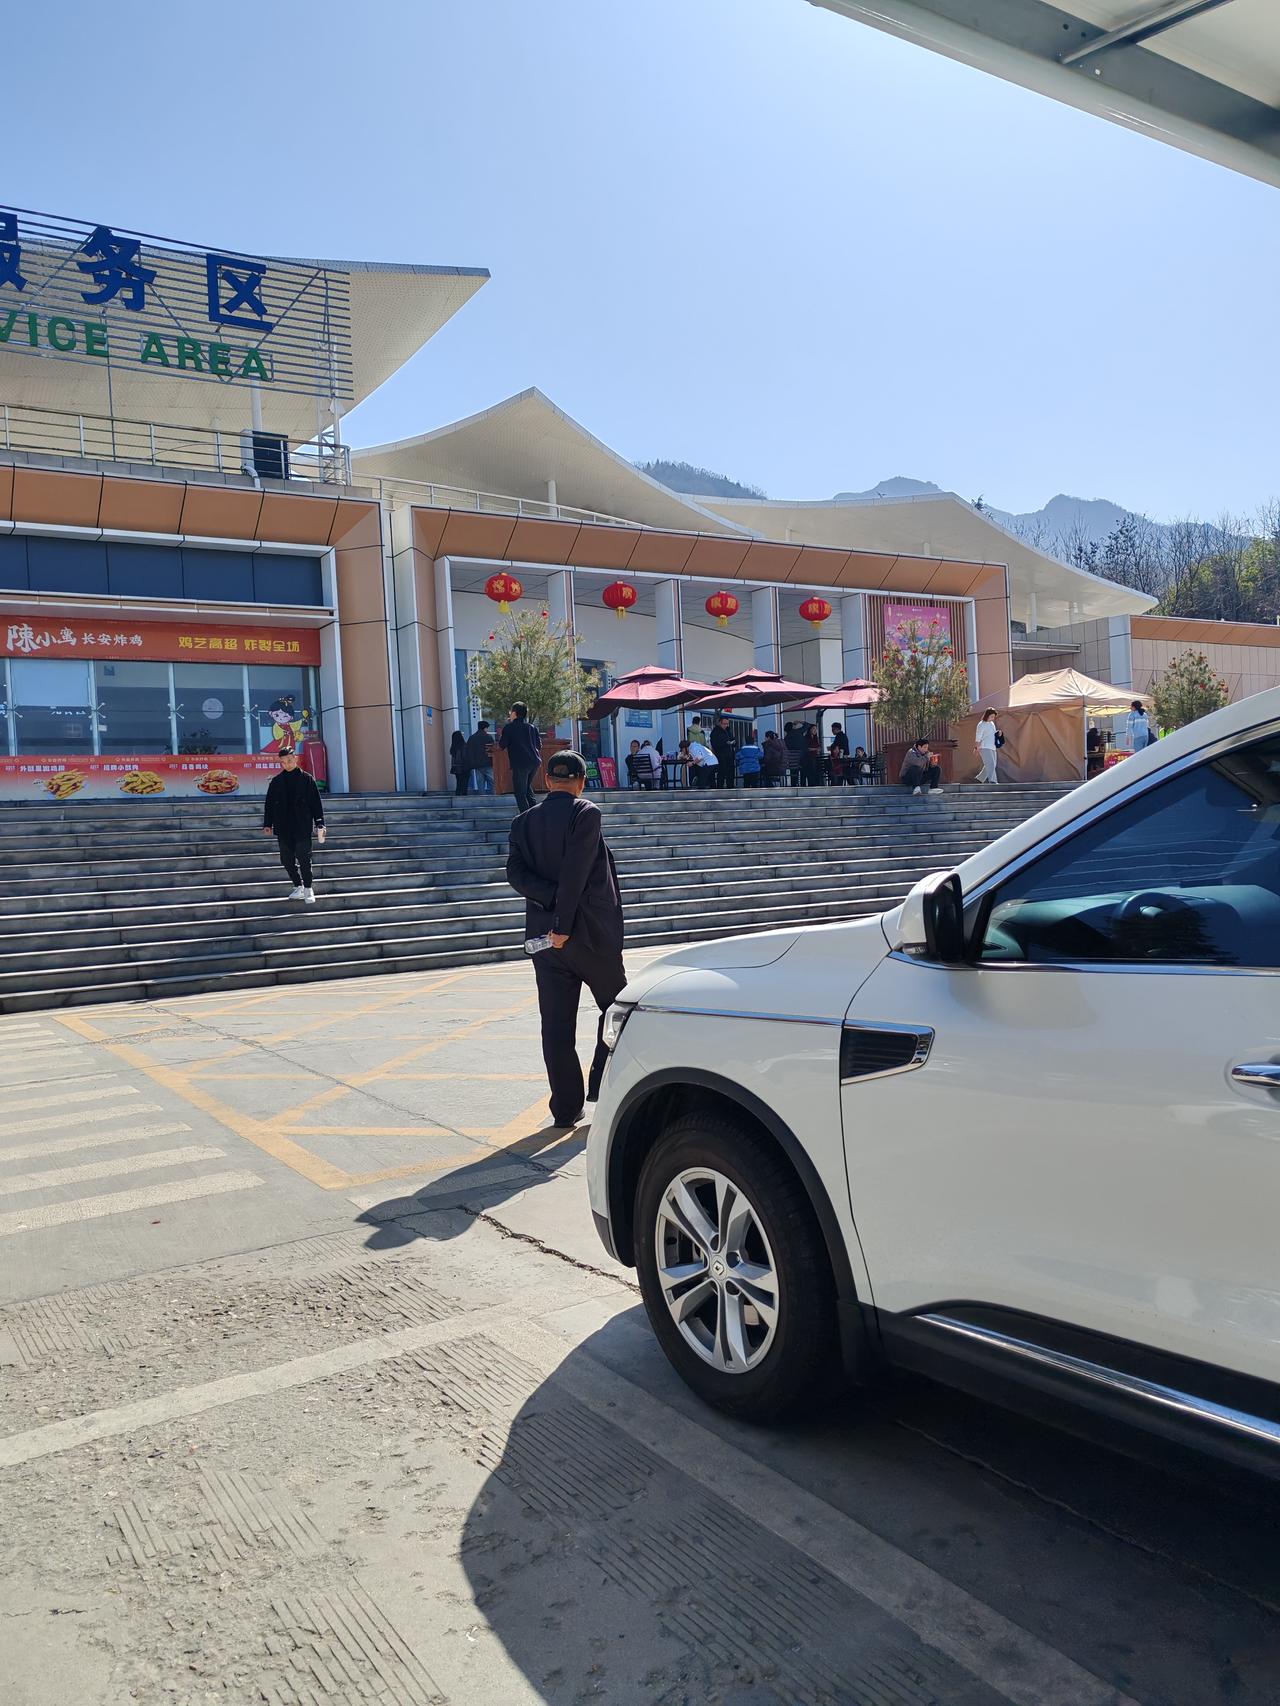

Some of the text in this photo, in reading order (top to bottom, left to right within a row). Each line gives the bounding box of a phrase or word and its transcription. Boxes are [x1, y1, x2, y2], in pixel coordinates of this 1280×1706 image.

[140, 332, 270, 381] AREA
[82, 632, 144, 647] 长安炸鸡
[178, 636, 300, 653] 鸡艺高超 炸裂全场
